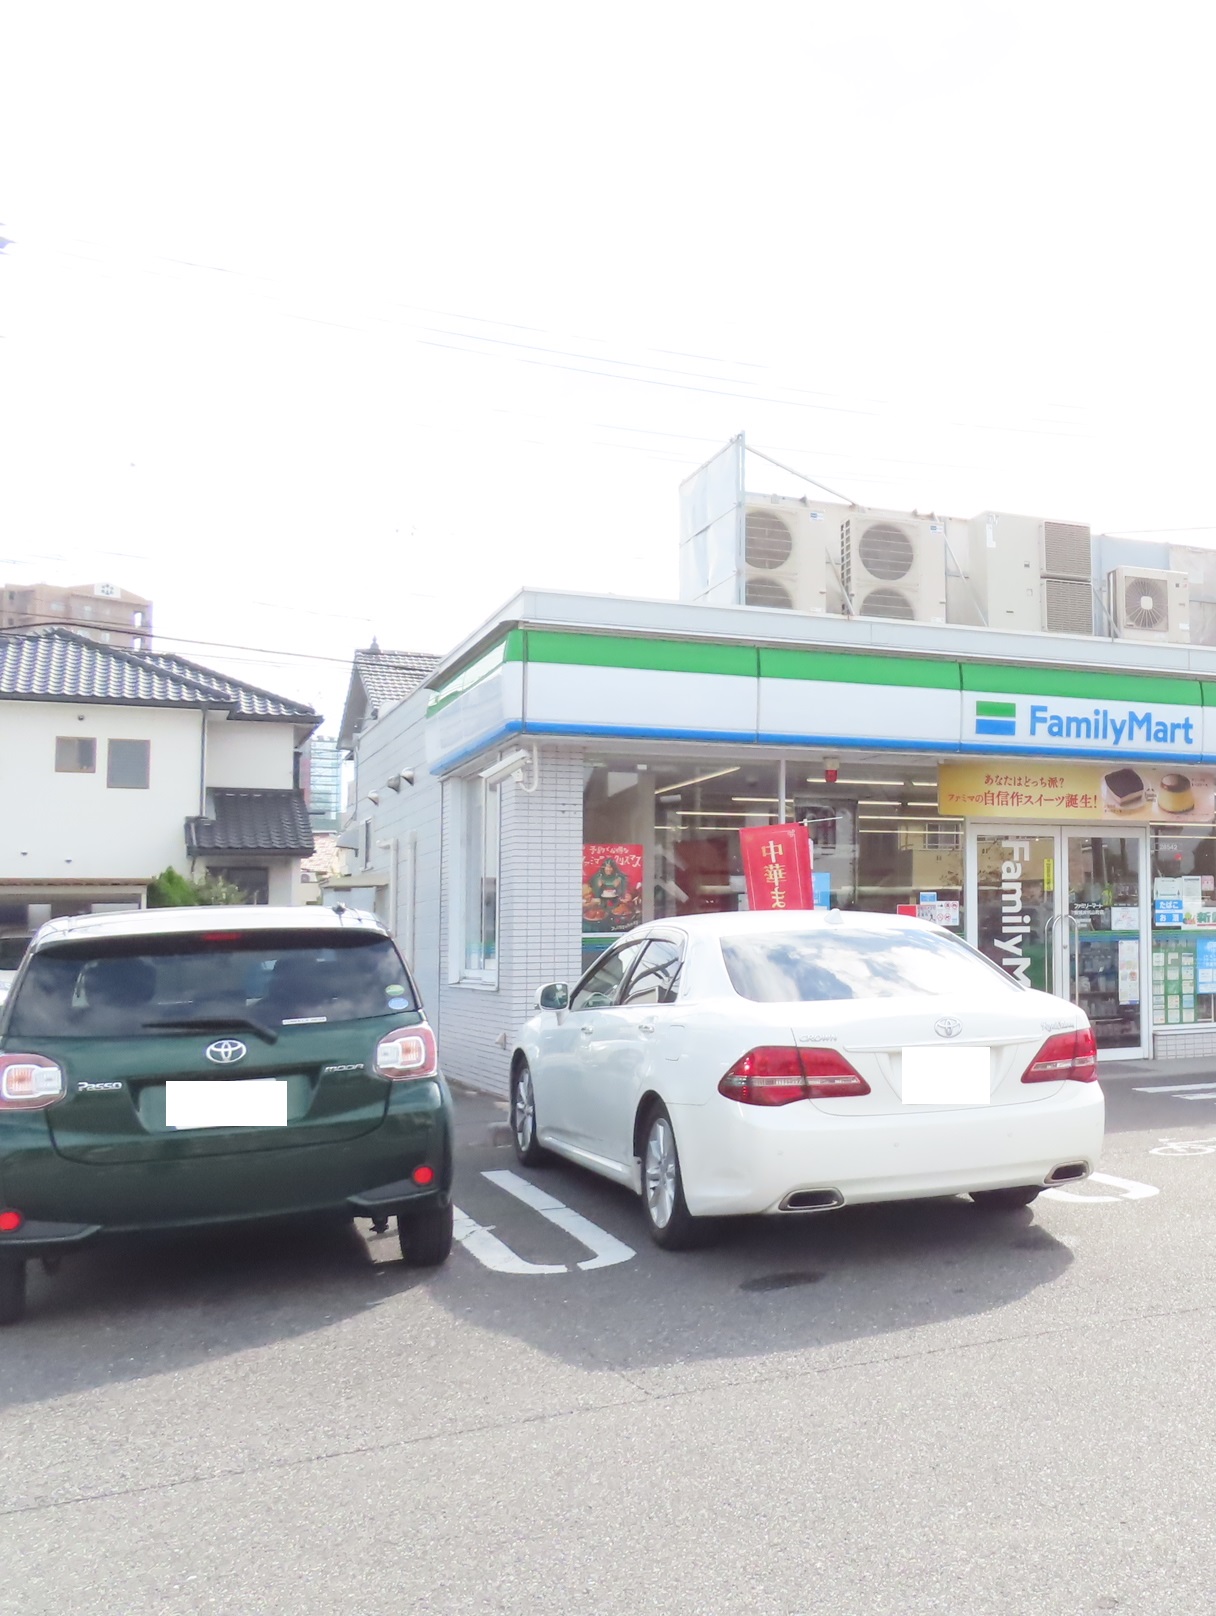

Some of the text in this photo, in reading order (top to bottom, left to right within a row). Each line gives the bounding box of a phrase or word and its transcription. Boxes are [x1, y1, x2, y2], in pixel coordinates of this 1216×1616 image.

[1029, 704, 1194, 746] FamilyMart
[984, 774, 1065, 789] あなたはどっち派?
[948, 790, 1098, 809] ファミマの自信作スイーツ誕生!
[1159, 901, 1180, 909] たばこ
[798, 1033, 838, 1043] CROWN
